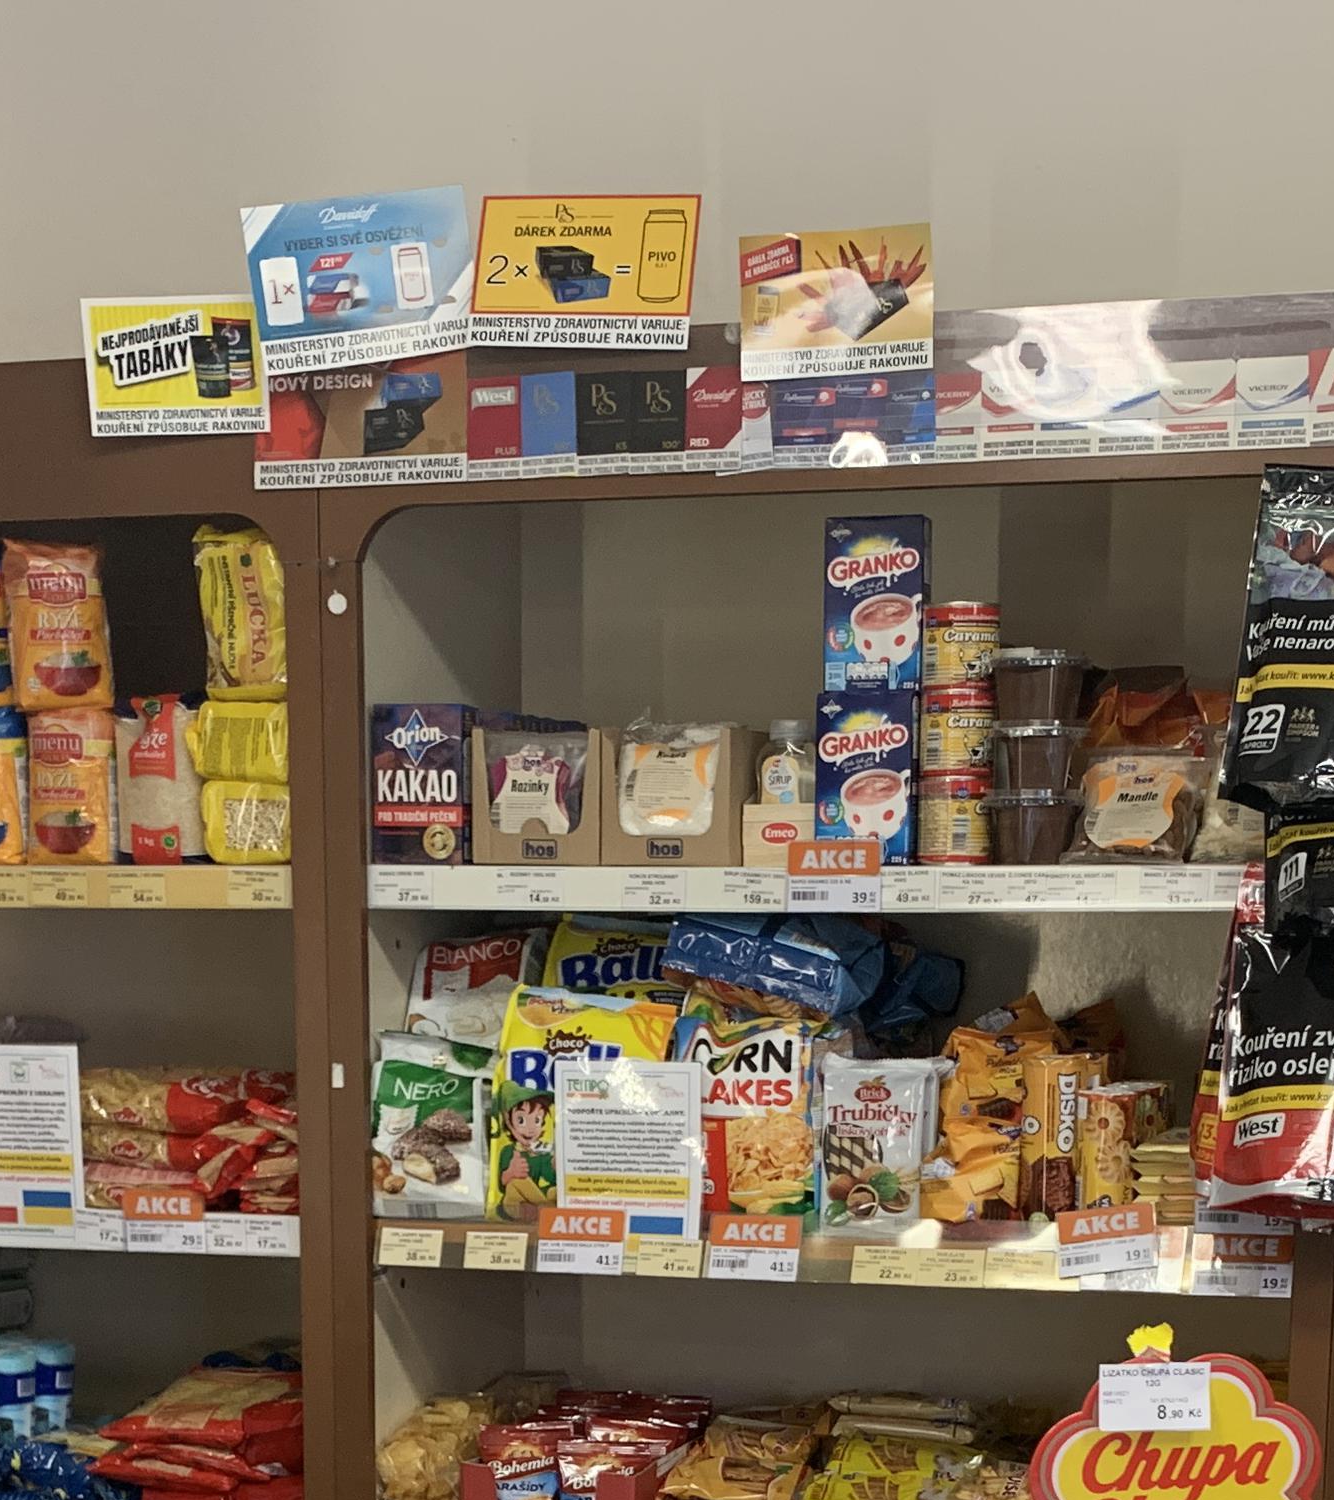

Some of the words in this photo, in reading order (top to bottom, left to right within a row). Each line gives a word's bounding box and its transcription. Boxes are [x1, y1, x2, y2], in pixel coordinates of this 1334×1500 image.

[514, 223, 555, 238] DÁREK
[559, 225, 612, 237] ZDARMA
[648, 251, 676, 263] PIVO
[101, 315, 200, 352] NEJPRODÁVANĚJŠÍ
[473, 317, 550, 329] MINISTERSTVO
[554, 316, 639, 329] ZDRAVOTNICTVÍ
[643, 320, 685, 331] VARUJE:
[470, 328, 529, 344] KOUŘENÍ
[534, 328, 611, 345] ZPŮSOBUJE
[616, 333, 684, 346] RAKOVINU
[115, 340, 188, 382] TABÁKY
[328, 373, 373, 391] DESIGN
[475, 389, 514, 404] West
[95, 410, 158, 421] MINISTERSTVO
[161, 408, 226, 421] ZDRAVOTNICTVÍ
[229, 409, 265, 419] VARUJE:
[97, 420, 144, 433] KOUŘENÍ
[147, 419, 205, 433] ZPŮSOBUJE
[208, 420, 265, 431] RAKOVINU
[392, 726, 443, 747] Orion
[820, 724, 908, 757] GRANKO
[376, 767, 458, 806] KAKAO
[509, 776, 550, 798] Rozinky
[1116, 789, 1159, 806] Mandle
[649, 838, 681, 858] hos
[432, 939, 520, 963] BIANCO
[549, 1036, 584, 1050] Choco
[1231, 1025, 1311, 1056] Kouření
[1229, 1059, 1276, 1087] riziko
[394, 1077, 459, 1099] NERO
[828, 1103, 917, 1126] Trubičky
[1057, 1072, 1077, 1153] DISKO
[1238, 1116, 1279, 1139] West
[1071, 1211, 1140, 1237] AKCE
[1103, 1369, 1139, 1377] LIZATKO
[1173, 1368, 1205, 1376] CLASIC
